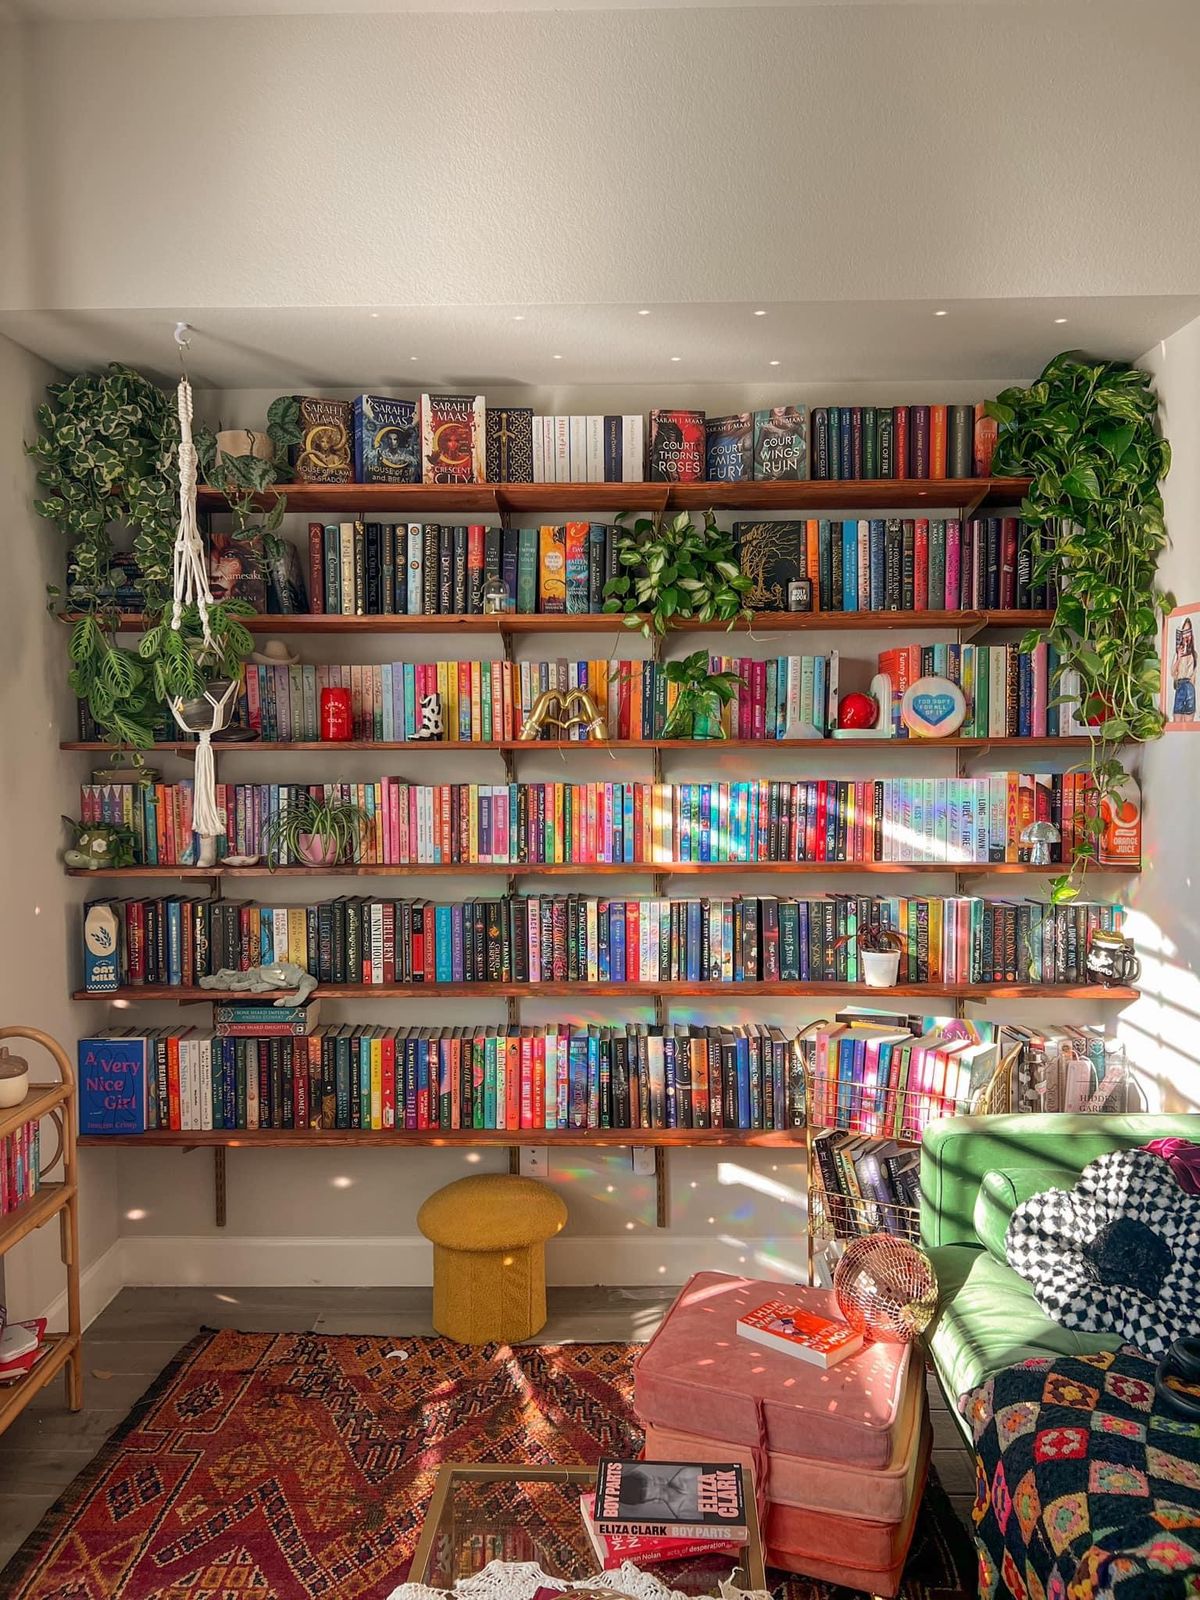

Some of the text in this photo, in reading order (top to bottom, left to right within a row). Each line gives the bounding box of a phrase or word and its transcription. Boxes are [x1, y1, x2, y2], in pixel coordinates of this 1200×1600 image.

[306, 403, 333, 414] SARAH
[374, 403, 403, 414] SARAH
[432, 402, 463, 411] SARAH
[310, 414, 340, 424] MAAS
[379, 414, 408, 424] MAAS
[437, 412, 468, 421] MAAS
[663, 441, 693, 450] COURT
[763, 436, 797, 447] COURT
[659, 451, 699, 460] THORNS
[711, 444, 742, 455] COURT
[761, 448, 799, 459] WINGS
[883, 449, 888, 458] OF
[658, 461, 700, 472] ROSES
[715, 454, 743, 465] MIST
[763, 459, 797, 472] RUIN
[709, 465, 744, 478] FURY
[436, 474, 472, 484] CITY
[456, 556, 464, 582] DEFEND
[1018, 549, 1029, 584] CARAVAL
[472, 556, 480, 605] DESTROY DAY
[442, 583, 450, 607] NIGHT
[898, 653, 906, 675] Funny
[898, 677, 906, 696] Story
[1113, 838, 1138, 846] ORANGE
[384, 919, 393, 963] HELL BENT
[983, 912, 992, 963] GODSGRAVE
[994, 909, 1003, 963] NEVERNIGHT
[1005, 911, 1014, 963] DARKDAWN
[130, 920, 139, 971] ALLEGIANT
[372, 919, 382, 970] NINTH HOUSE
[93, 966, 114, 974] OAT
[85, 1052, 96, 1065] A
[180, 1045, 188, 1062] Blue
[497, 1040, 505, 1075] Adelaide
[101, 1056, 140, 1076] Very
[158, 1044, 167, 1099] HELLO BEAUTIFUL
[87, 1077, 124, 1091] Nice
[104, 1095, 136, 1110] Girl
[1080, 1094, 1118, 1103] HIDDEN
[1078, 1104, 1119, 1112] GARDEN
[754, 1301, 782, 1317] WITH
[828, 1330, 851, 1344] HOW
[812, 1343, 829, 1351] TO
[606, 1463, 622, 1495] PARTS
[697, 1474, 717, 1512] ELIZA
[716, 1471, 739, 1517] CLARK
[603, 1496, 619, 1517] BOY
[600, 1525, 731, 1538] ELIZA CLARK BOY PARTS
[642, 1552, 661, 1560] Nolan
[689, 1541, 725, 1553] desperation
